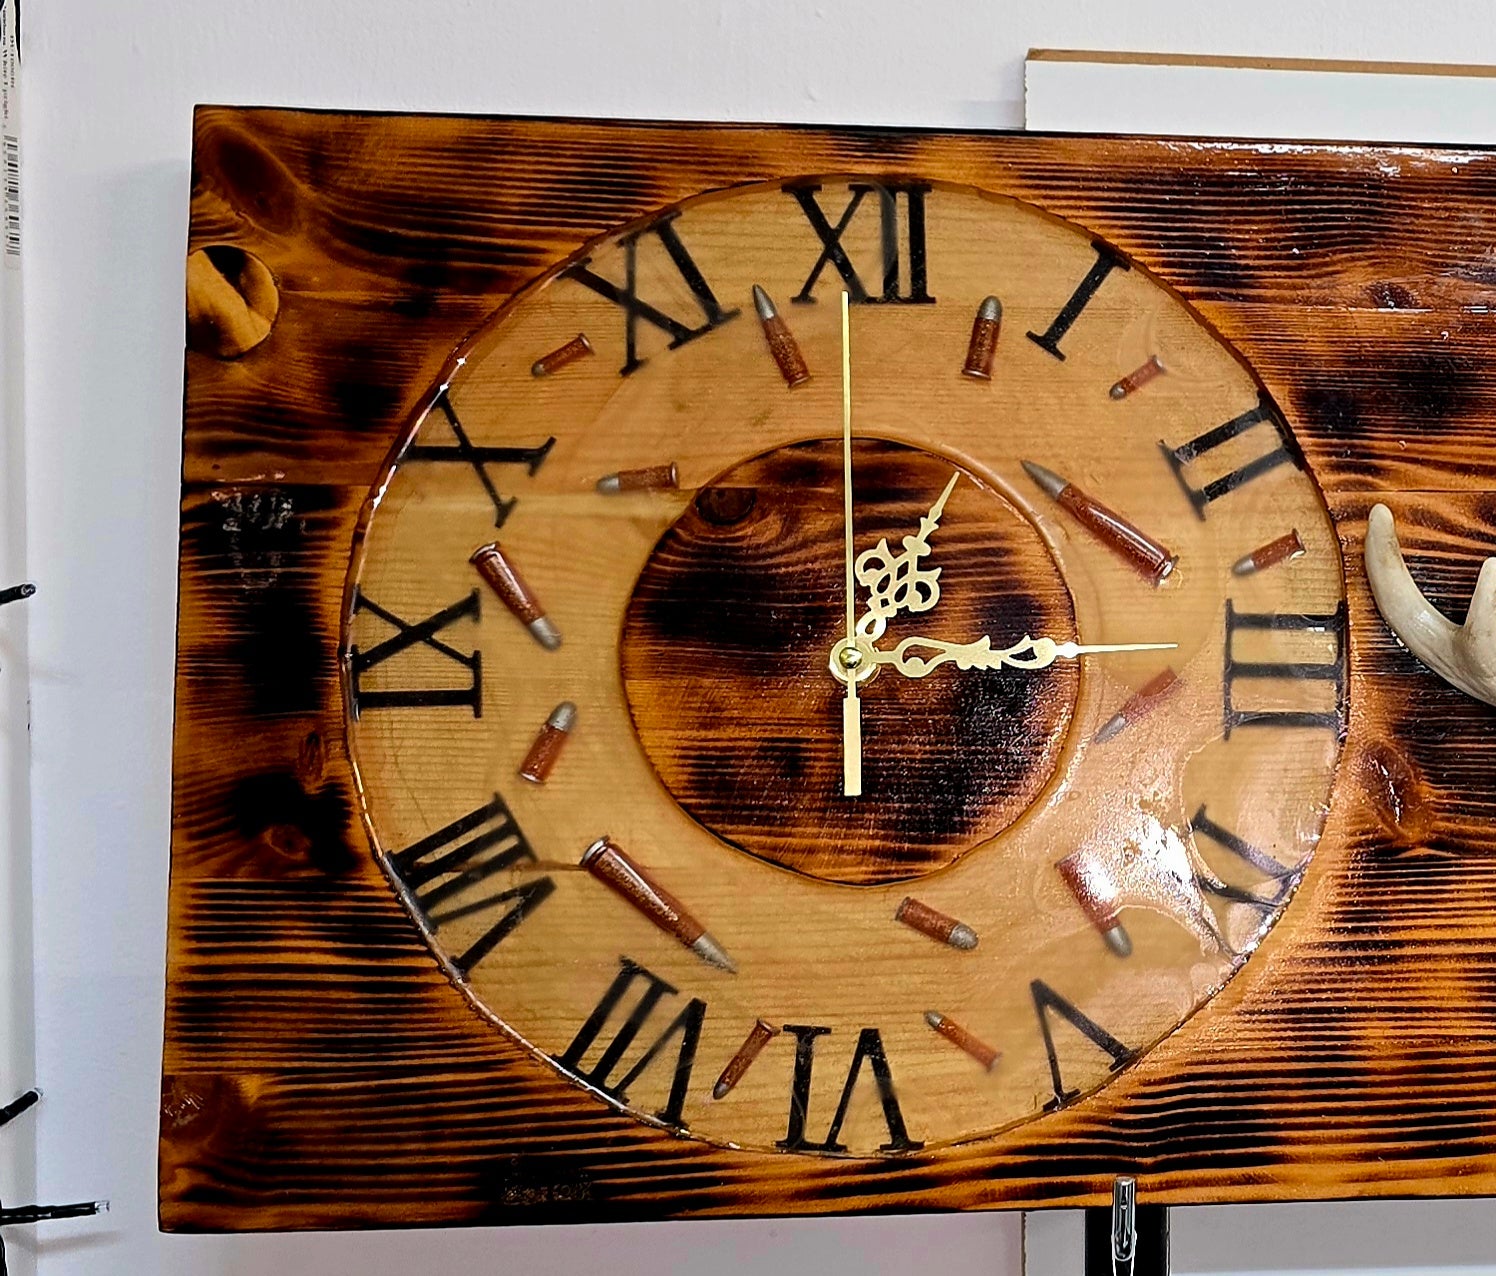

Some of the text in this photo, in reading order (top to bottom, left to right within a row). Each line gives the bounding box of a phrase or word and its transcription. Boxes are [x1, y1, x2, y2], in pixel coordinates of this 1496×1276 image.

[557, 211, 741, 377] XI
[781, 181, 937, 304] XII
[1026, 239, 1131, 361] I
[396, 388, 557, 528] X
[1157, 389, 1305, 521] II
[350, 584, 482, 722] IX
[1224, 598, 1348, 743] III
[385, 792, 558, 982] VIII
[552, 956, 707, 1136] VII
[774, 1024, 925, 1153] VI
[1030, 978, 1140, 1111] V
